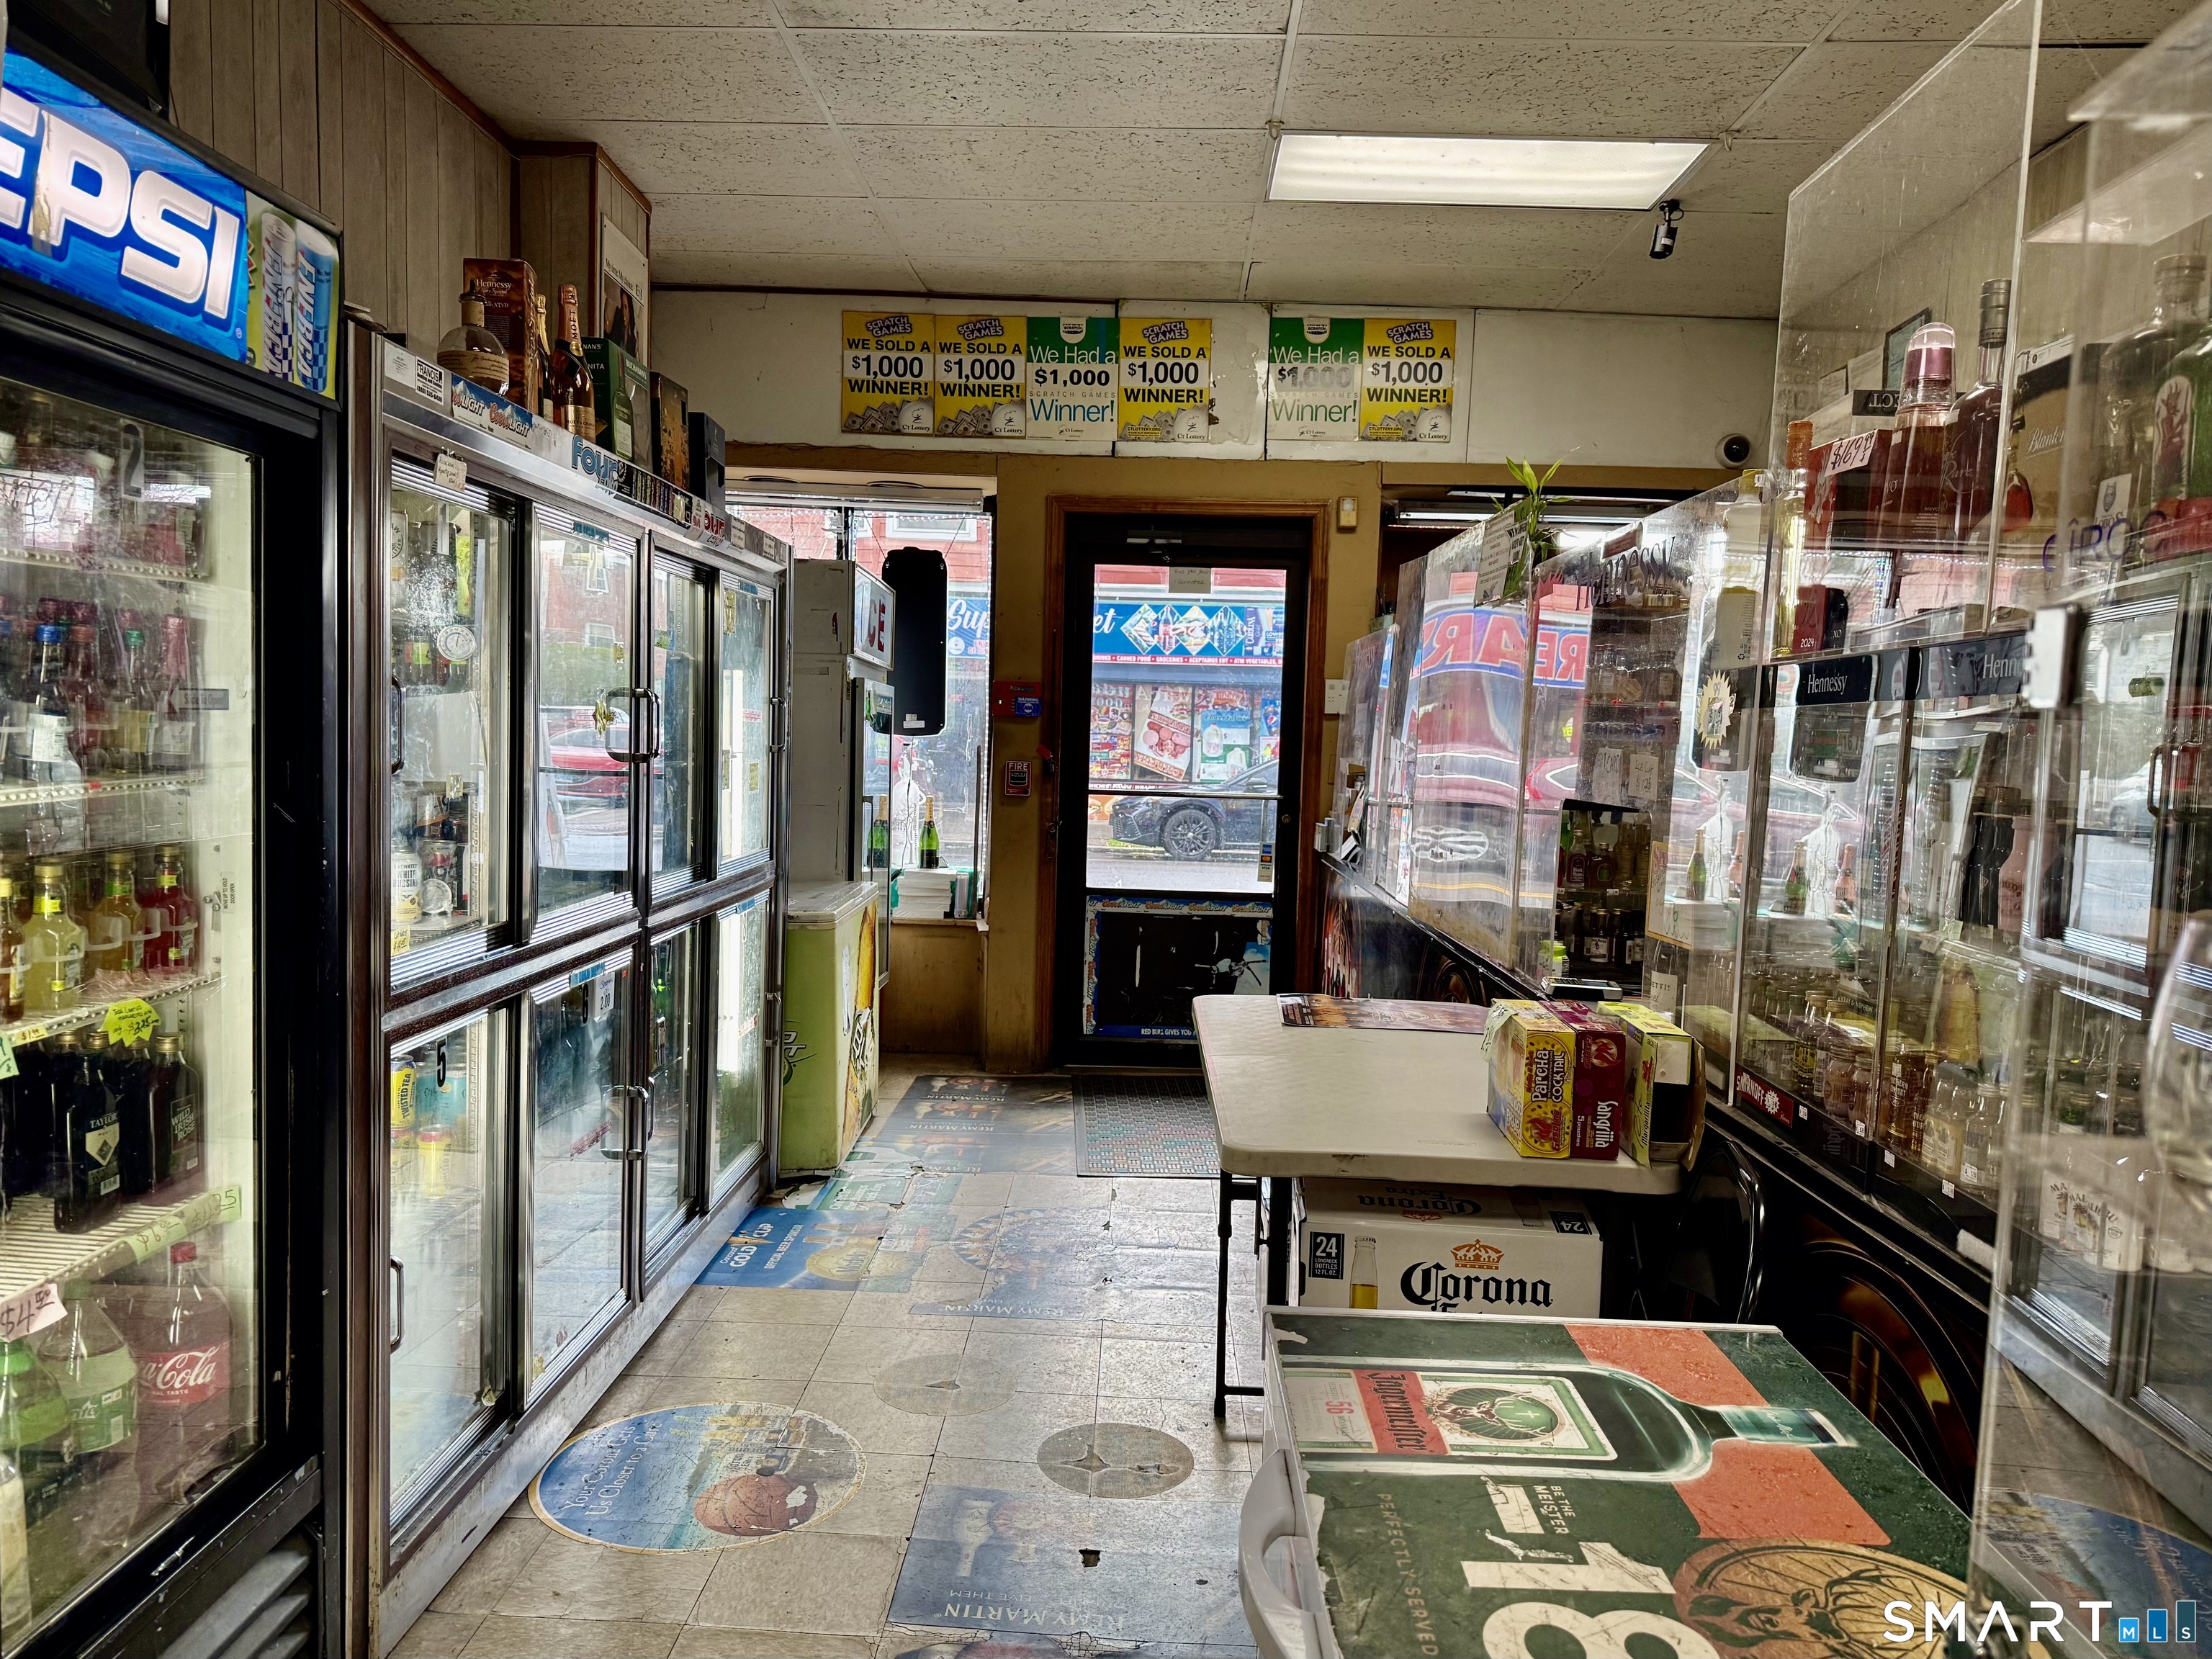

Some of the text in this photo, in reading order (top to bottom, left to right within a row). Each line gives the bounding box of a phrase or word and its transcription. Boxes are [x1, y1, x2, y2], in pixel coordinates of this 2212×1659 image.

[477, 279, 511, 289] Hennessy
[867, 317, 907, 331] SCRATCH
[873, 324, 912, 336] GAMES
[958, 319, 999, 334] SCRATCH
[965, 327, 1003, 340] GAMES
[1143, 322, 1184, 337] SCRATCH
[1388, 322, 1428, 337] SCRATCH
[847, 338, 931, 352] WE SOLD A
[1149, 330, 1187, 343] GAMES
[1393, 330, 1432, 343] GAMES
[939, 342, 1022, 354] WE SOLD A
[1030, 346, 1115, 364] We Had a
[1123, 346, 1206, 358] WE SOLD A
[1273, 346, 1359, 364] We Had a
[1367, 346, 1450, 359] WE SOLD A
[852, 355, 923, 379] $1,000
[944, 358, 1015, 382] $1,000
[1128, 361, 1198, 386] $1,000
[1371, 361, 1443, 386] $1,000
[1035, 367, 1110, 387] $1,000
[848, 379, 928, 395] WINNER!
[940, 383, 1020, 397] WINNER!
[1124, 388, 1203, 403] WINNER!
[1367, 388, 1447, 403] WINNER!
[462, 395, 485, 416] LIGHT
[1030, 399, 1114, 422] Winner!
[1272, 399, 1357, 422] Winner!
[508, 418, 529, 437] LIGHT
[1576, 536, 1676, 611] Hennessy
[1801, 639, 1815, 647] 2024
[1808, 674, 1848, 695] Hennessy
[1009, 763, 1028, 771] FIRE
[583, 984, 588, 1023] 6
[437, 1039, 446, 1087] 5
[1552, 1051, 1565, 1102] COCKTAIL
[400, 1074, 411, 1119] TWISTED TEA
[89, 1113, 118, 1128] TAYLOR
[171, 1108, 190, 1126] WILD
[174, 1113, 194, 1133] IRISH
[178, 1122, 195, 1141] ROSE
[1357, 1193, 1483, 1215] Corona
[1560, 1220, 1584, 1232] 24
[729, 1223, 773, 1267] GOLD CUP
[764, 1251, 785, 1269] OFFICIAL
[784, 1224, 804, 1241] SPONSOR
[1316, 1236, 1338, 1257] 24
[1401, 1262, 1554, 1312] Corona
[1325, 1401, 1354, 1414] 56
[633, 1423, 662, 1444] Cure
[626, 1453, 643, 1463] to
[560, 1426, 636, 1511] Your Corona Gets
[598, 1465, 634, 1498] Closer
[585, 1501, 613, 1515] Us
[1534, 1485, 1569, 1534] MEISTER
[1551, 1485, 1575, 1518] BE THE
[1377, 1493, 1439, 1656] PERFECTLY SERVED
[950, 1590, 1032, 1601] LIVE THEM
[944, 1603, 1046, 1625] MARTIN
